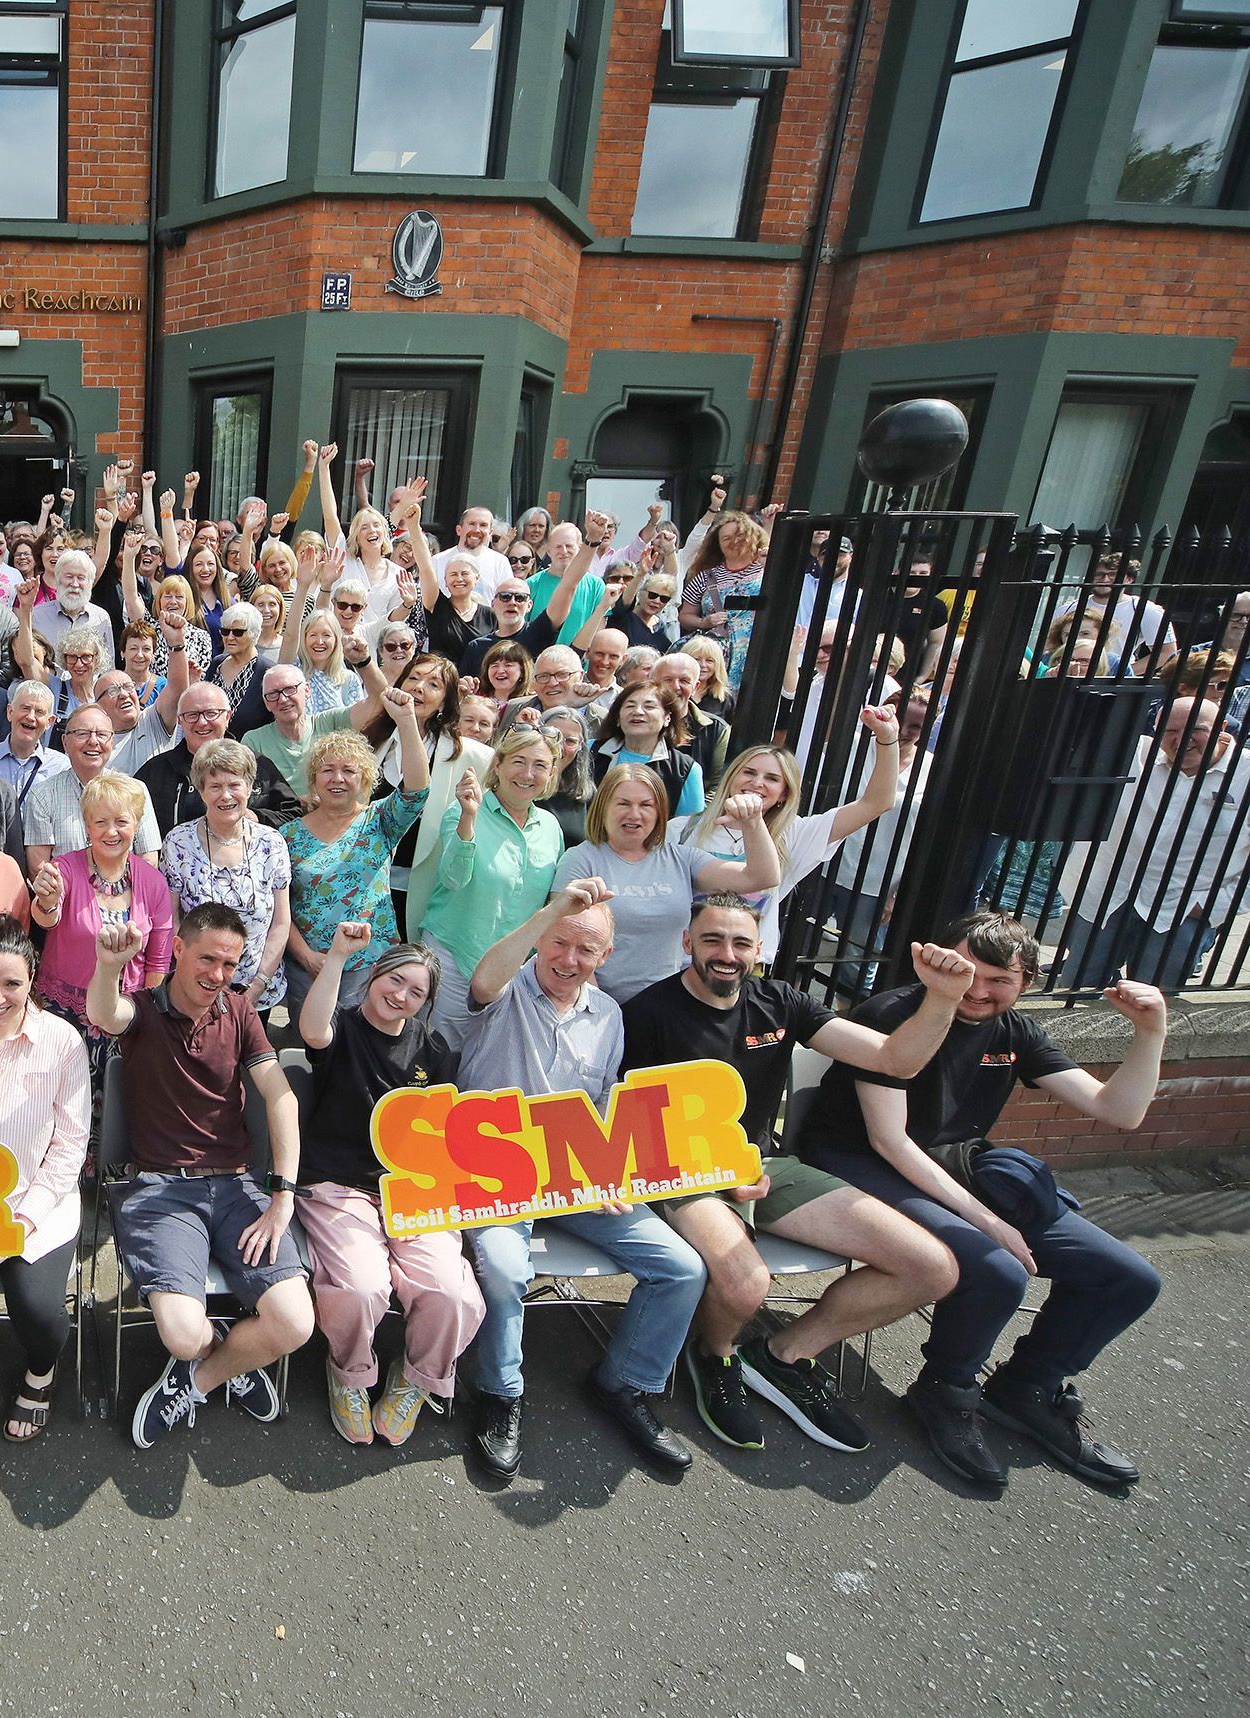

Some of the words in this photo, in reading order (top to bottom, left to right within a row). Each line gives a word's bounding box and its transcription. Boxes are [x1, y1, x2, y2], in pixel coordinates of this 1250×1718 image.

[23, 287, 142, 311] Reachtain
[326, 278, 347, 290] F.P.
[378, 1066, 758, 1218] SSMR
[391, 1205, 446, 1232] Scoil
[449, 1190, 569, 1224] Samhraidh
[571, 1183, 628, 1206] Mhic
[631, 1167, 737, 1197] Reachtain
